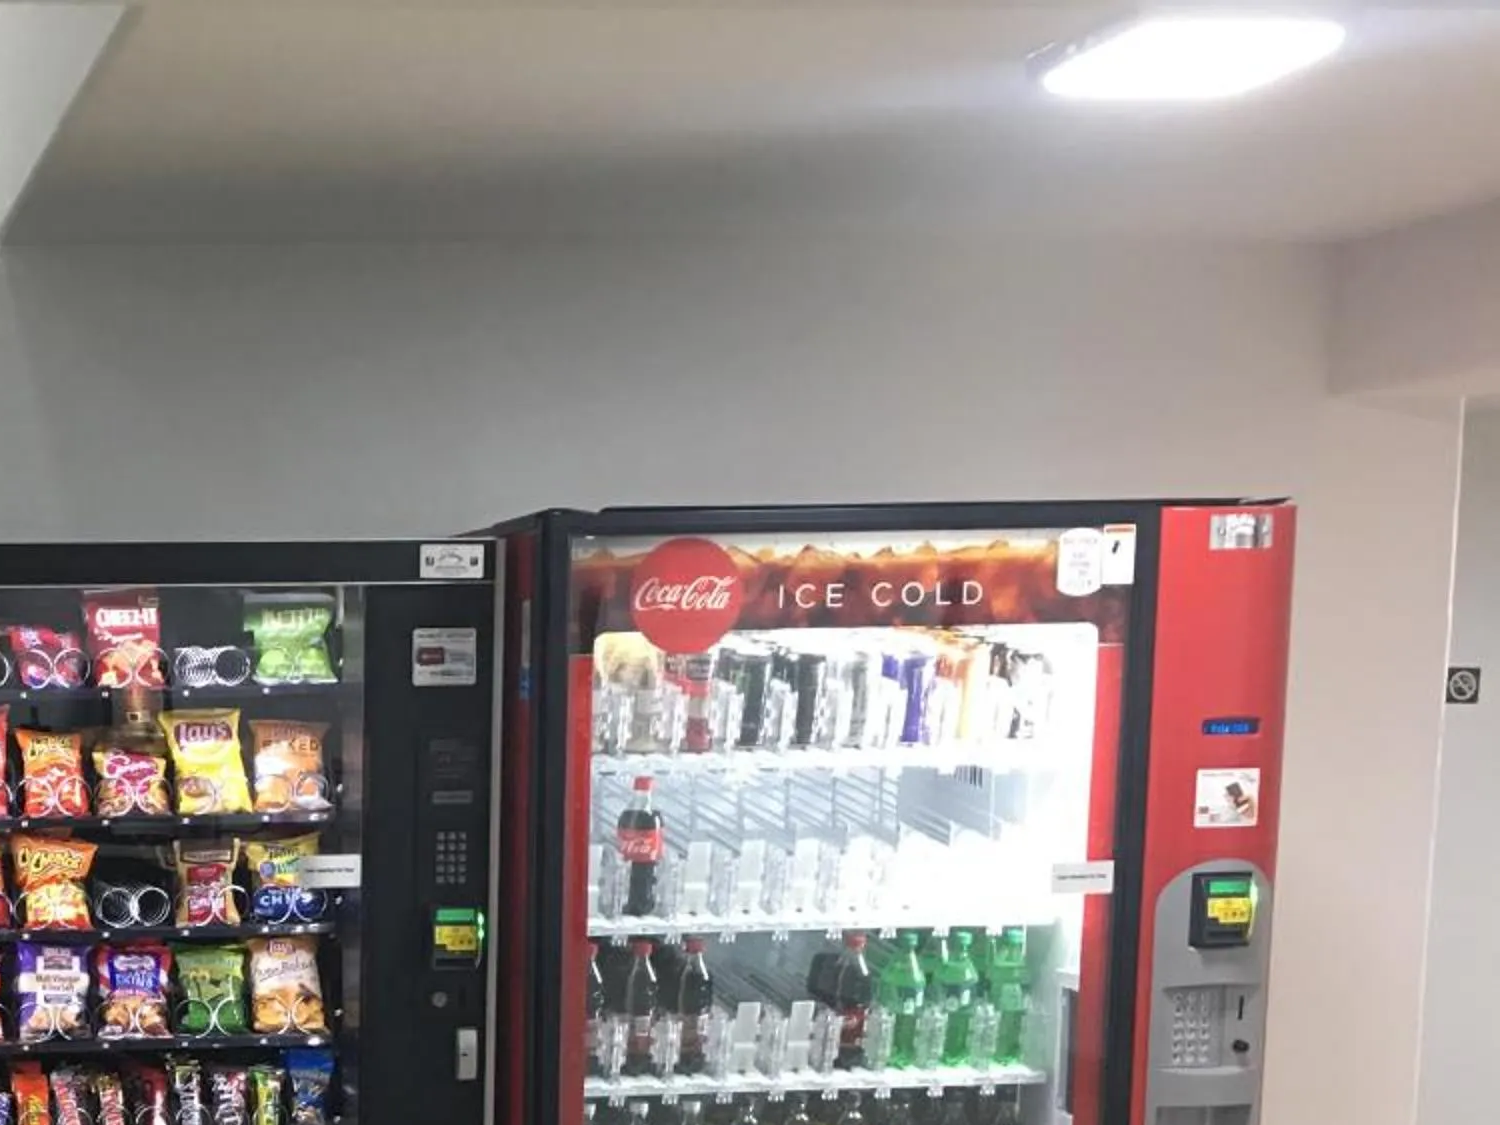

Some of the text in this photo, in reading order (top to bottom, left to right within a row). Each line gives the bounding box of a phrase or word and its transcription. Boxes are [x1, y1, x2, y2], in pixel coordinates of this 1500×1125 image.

[634, 575, 737, 612] Coca-Cola
[778, 579, 984, 610] ICE COLD
